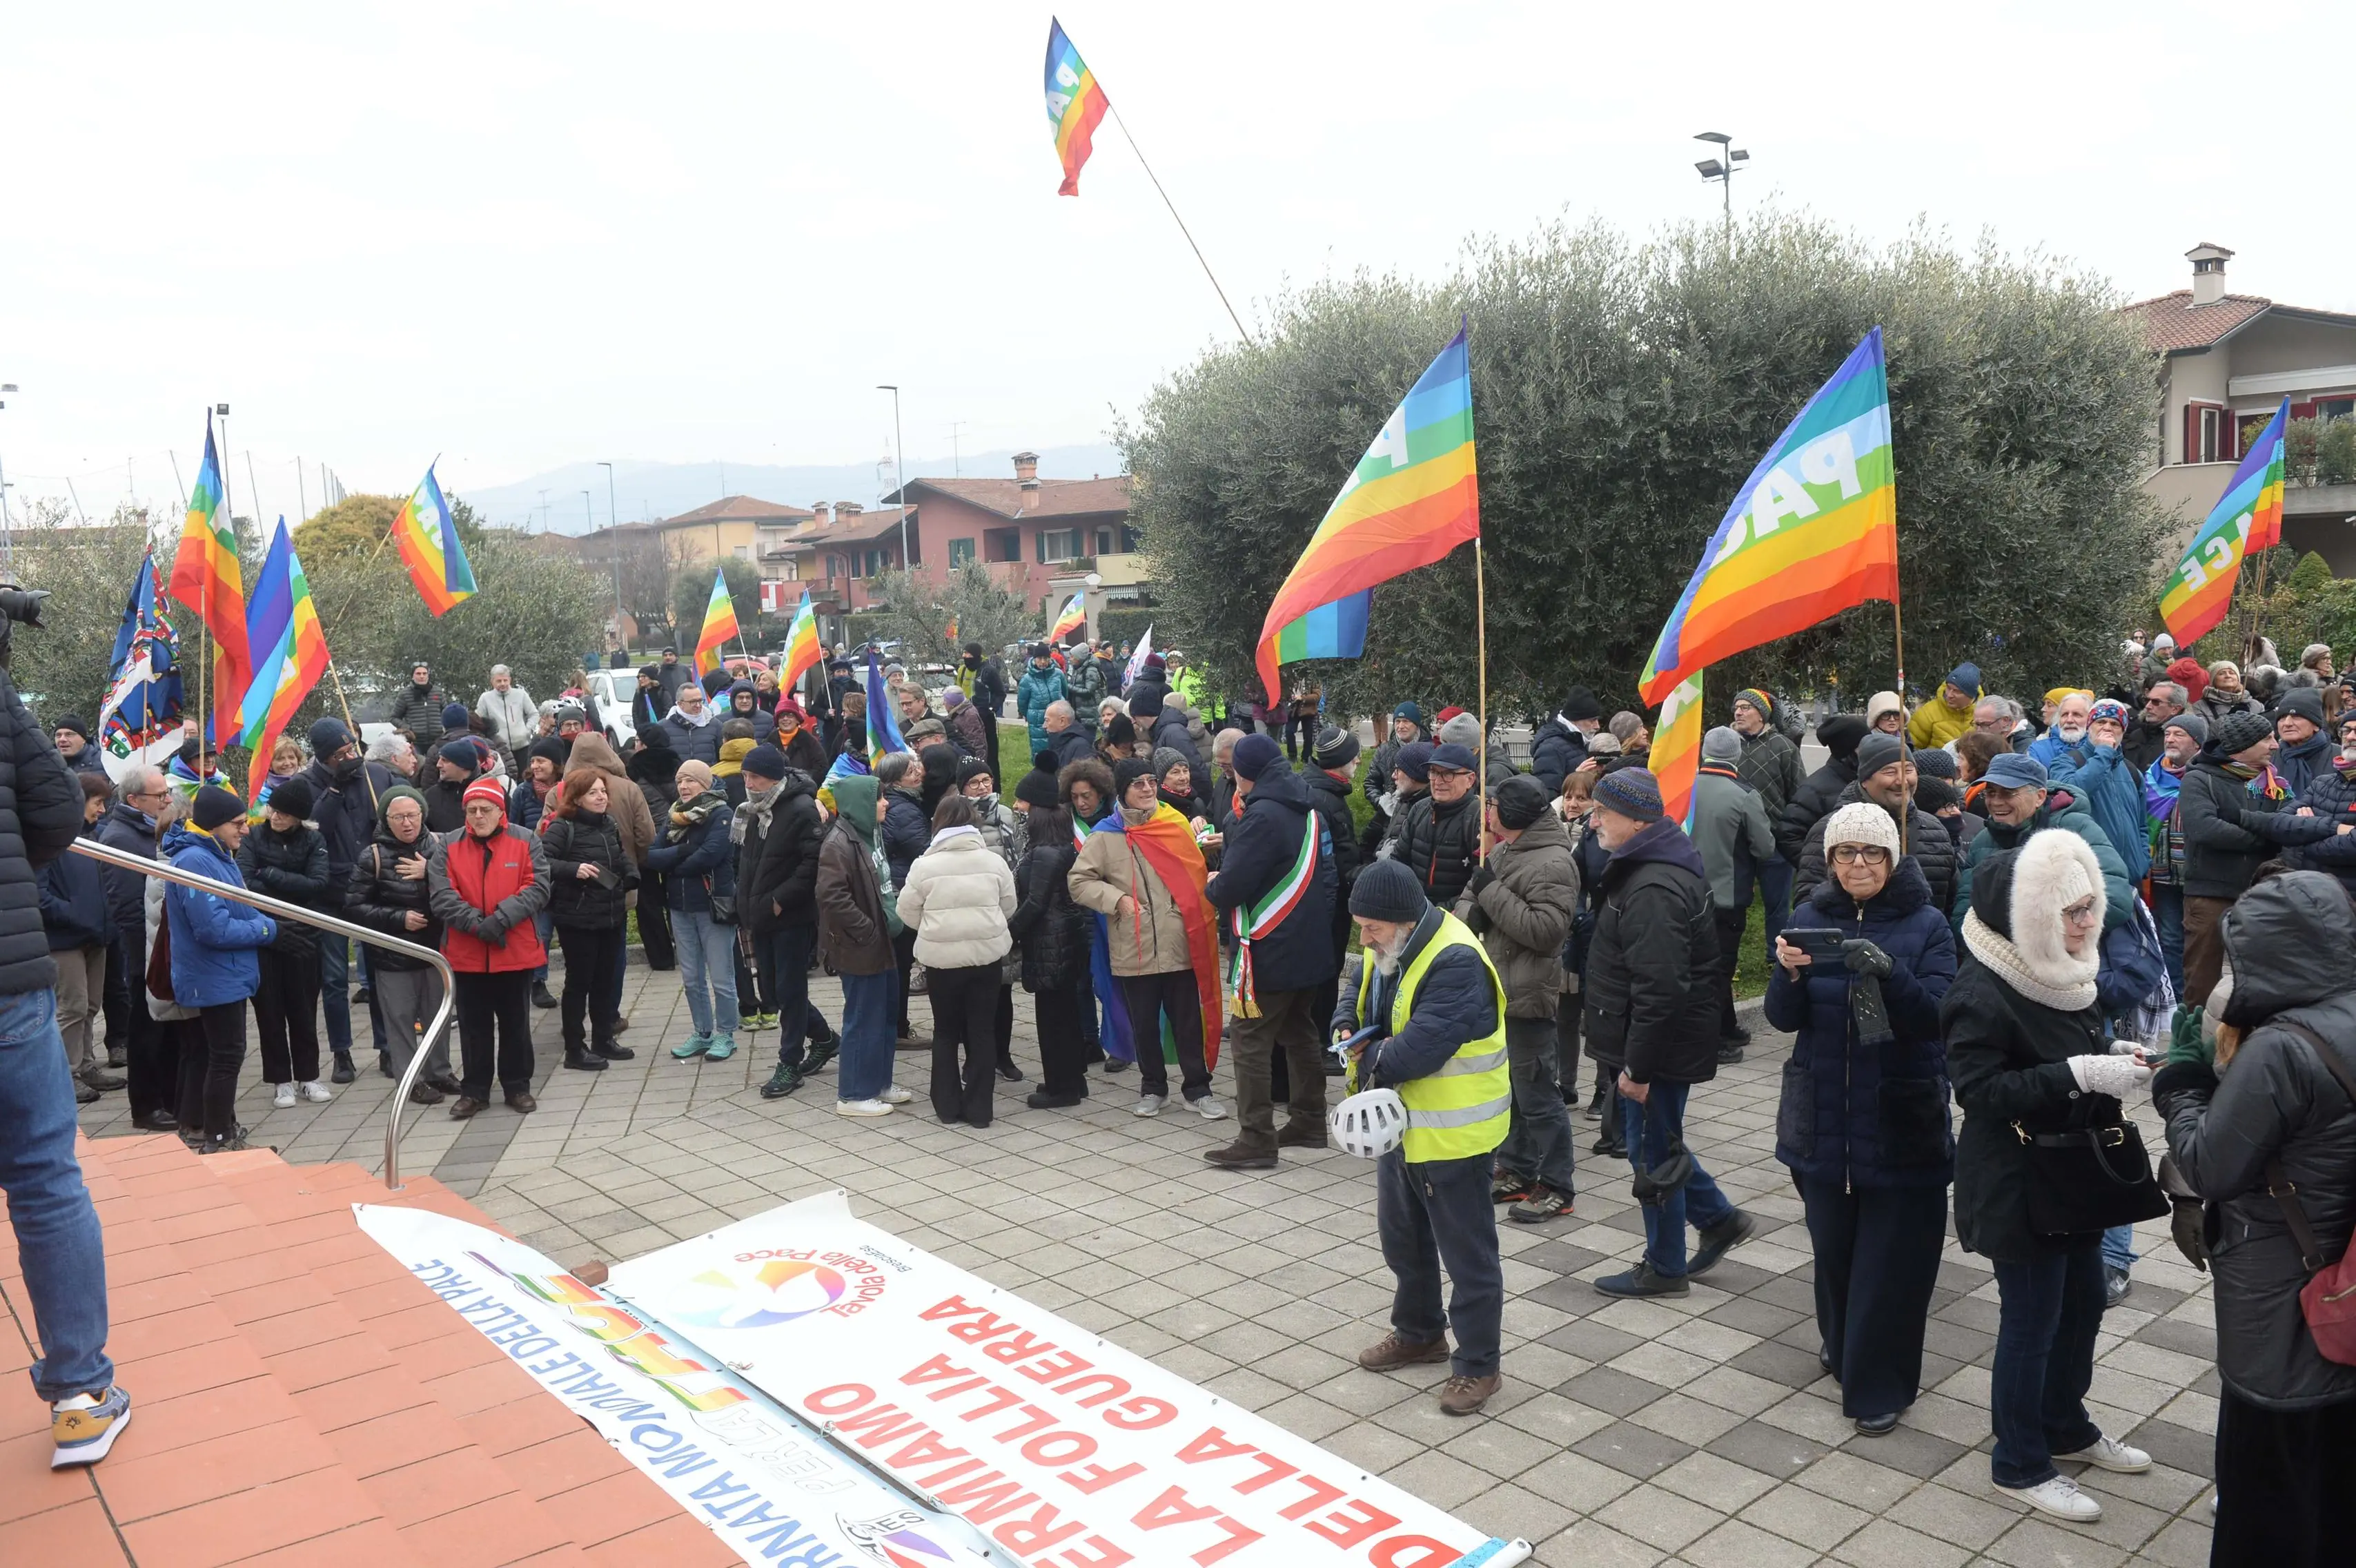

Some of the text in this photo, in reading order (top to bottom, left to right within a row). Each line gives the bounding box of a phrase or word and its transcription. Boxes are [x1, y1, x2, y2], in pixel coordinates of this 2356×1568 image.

[818, 1275, 886, 1317] Tavola
[820, 1251, 878, 1274] della
[412, 1259, 859, 1568] RNATA MONDIALE DELLA PACE
[899, 1353, 1264, 1567] LA FOLLIA
[917, 1295, 1465, 1568] DELLA GUERRA
